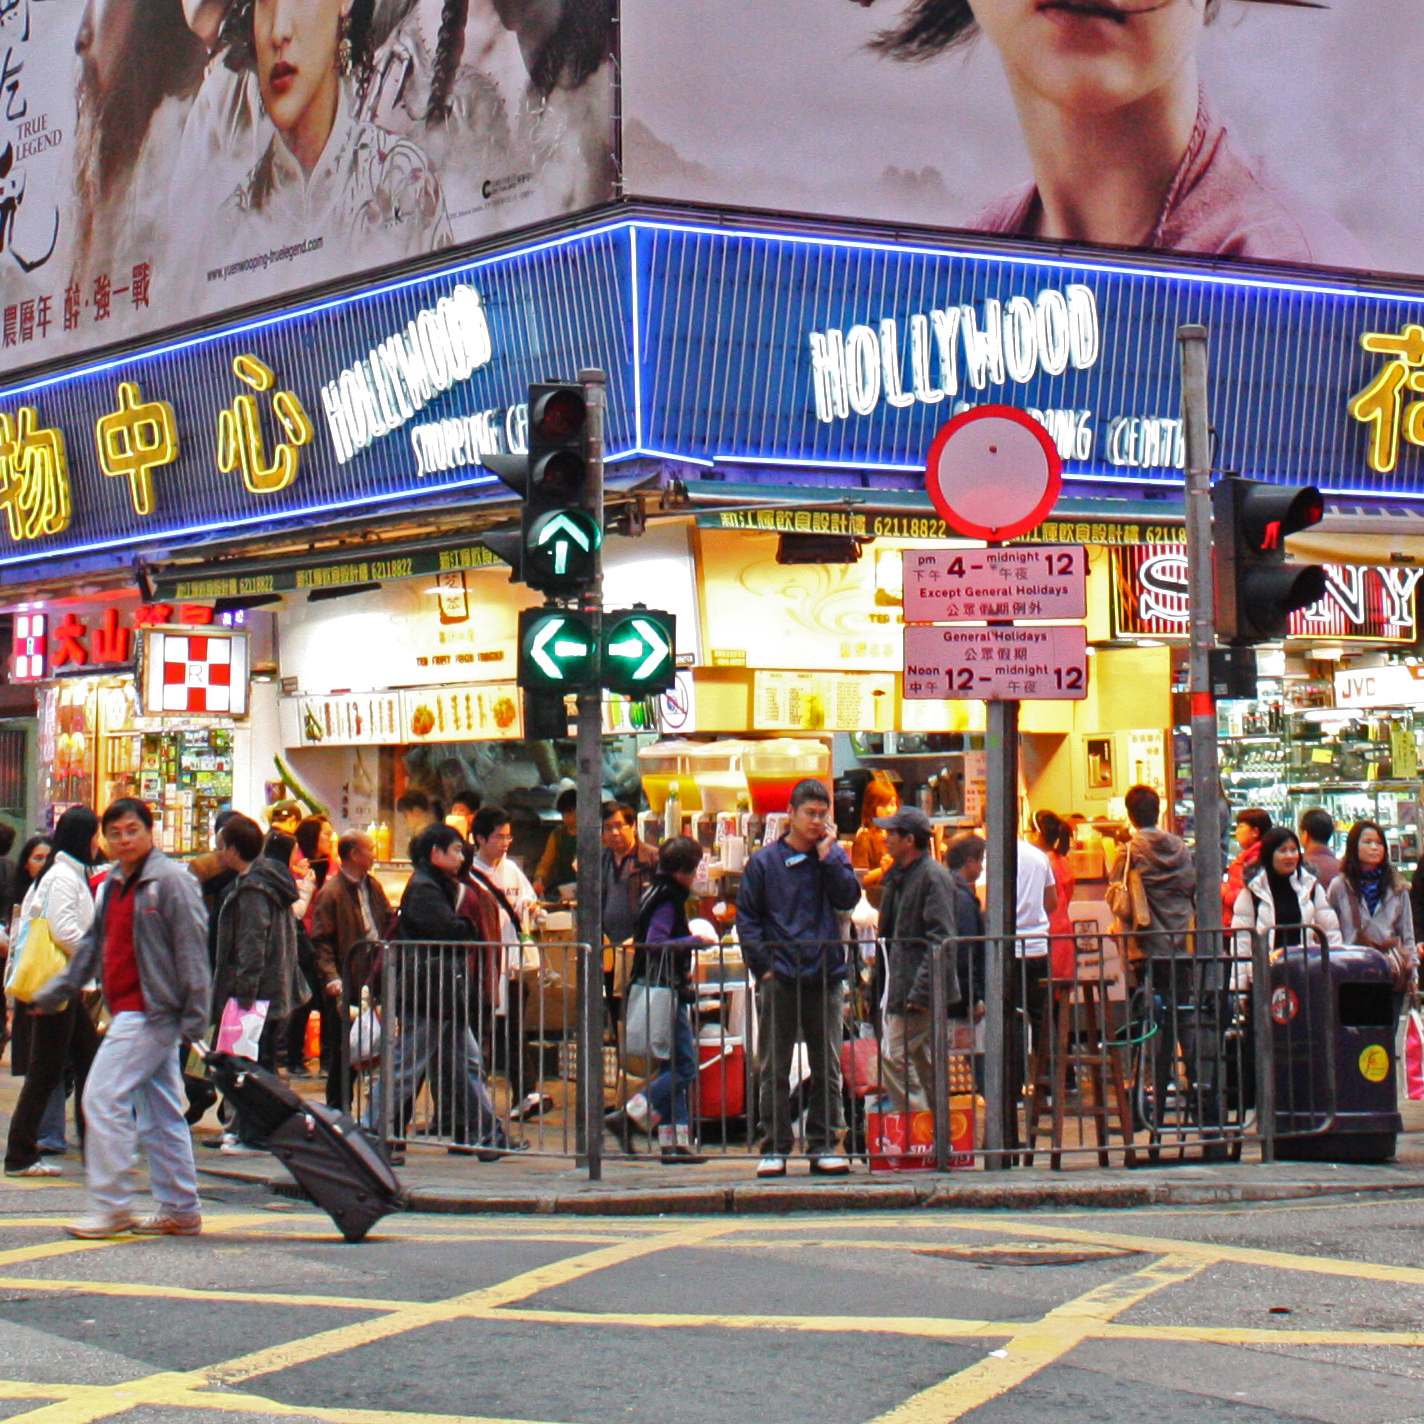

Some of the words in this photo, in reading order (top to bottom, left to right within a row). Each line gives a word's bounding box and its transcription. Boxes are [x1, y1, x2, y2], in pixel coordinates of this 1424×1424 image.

[17, 114, 49, 138] TRUE
[16, 128, 63, 161] LEGEND
[808, 284, 1099, 423] HOLLYWOOD
[321, 282, 492, 465] HOLLYWOOD
[873, 516, 947, 539] 62118822
[913, 569, 941, 582] 下午
[917, 554, 936, 567] pm
[947, 557, 966, 579] 4
[986, 551, 1040, 564] midnight
[1045, 553, 1074, 577] 12
[920, 587, 962, 599] Except
[964, 586, 1013, 597] General
[1016, 585, 1069, 597] Holidays
[943, 631, 992, 643] General
[995, 630, 1048, 643] Holidays
[908, 664, 940, 676] Noon
[944, 667, 974, 691] 12
[995, 664, 1049, 677] midnight
[1053, 667, 1083, 691] 12
[909, 681, 939, 694] 中午
